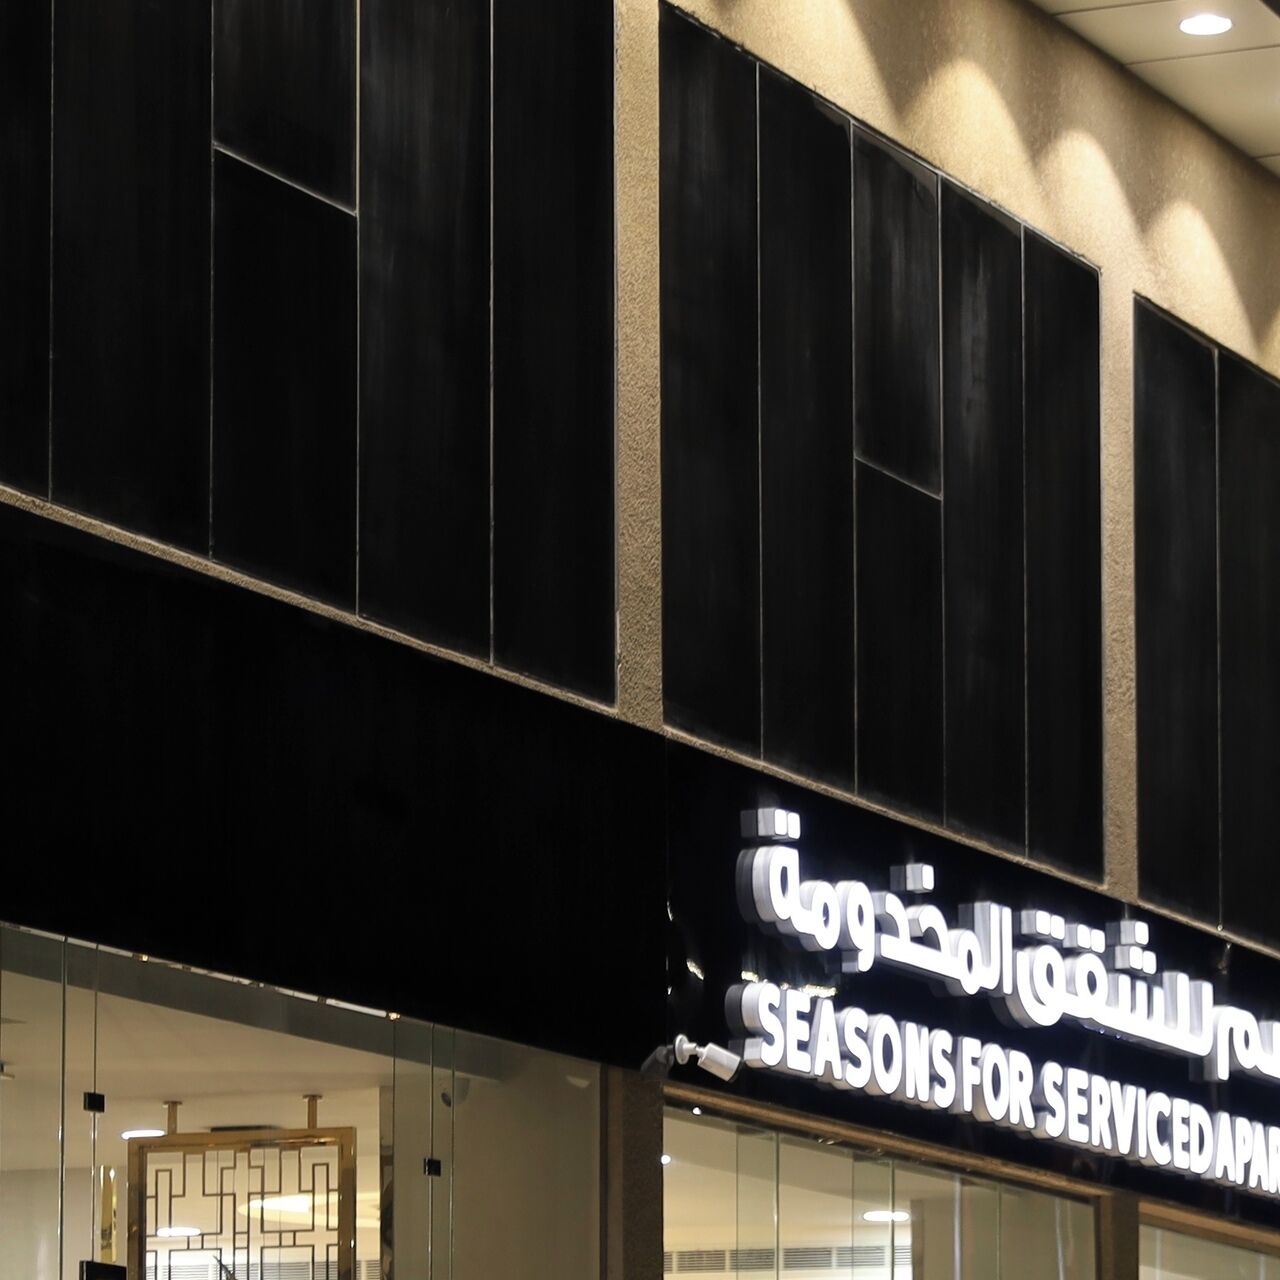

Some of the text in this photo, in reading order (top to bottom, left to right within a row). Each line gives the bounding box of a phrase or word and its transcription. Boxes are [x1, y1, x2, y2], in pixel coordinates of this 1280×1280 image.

[756, 807, 1013, 995] المخدومة
[1017, 909, 1213, 1056] للشقق
[752, 982, 955, 1109] SEASONS
[962, 1036, 1035, 1129] FOR
[1042, 1061, 1214, 1174] SERVICED
